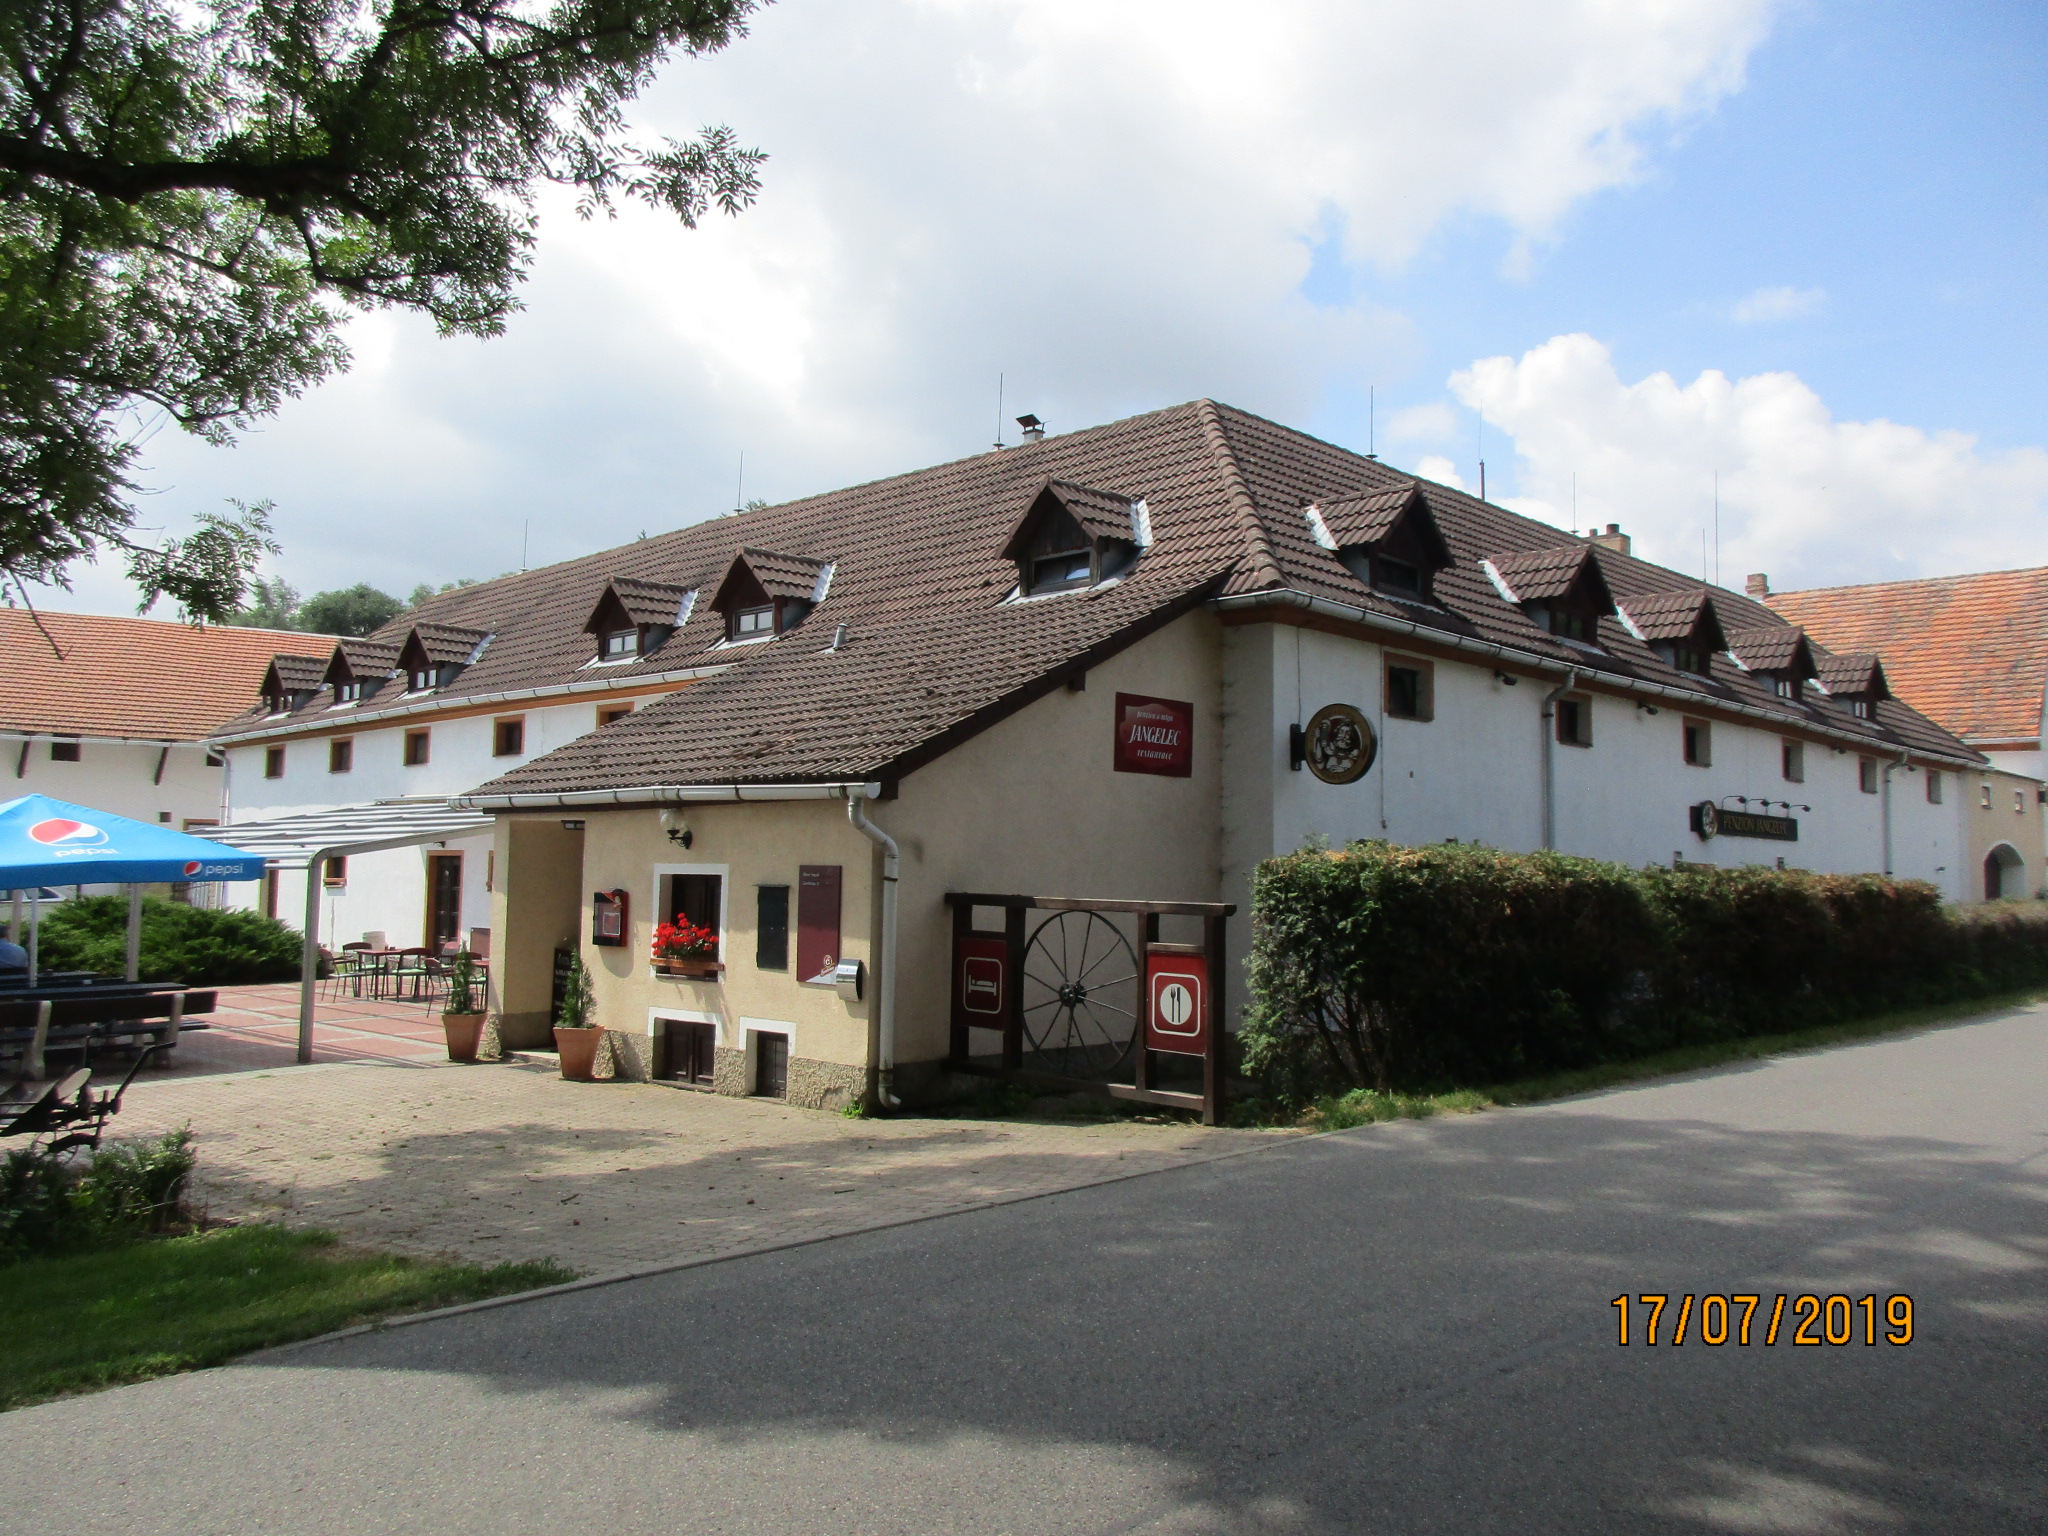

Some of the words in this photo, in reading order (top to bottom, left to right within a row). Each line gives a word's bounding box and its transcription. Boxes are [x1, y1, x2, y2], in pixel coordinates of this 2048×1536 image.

[1128, 725, 1181, 745] JANGELEC
[54, 848, 119, 858] pepsi
[205, 863, 244, 877] pepsi
